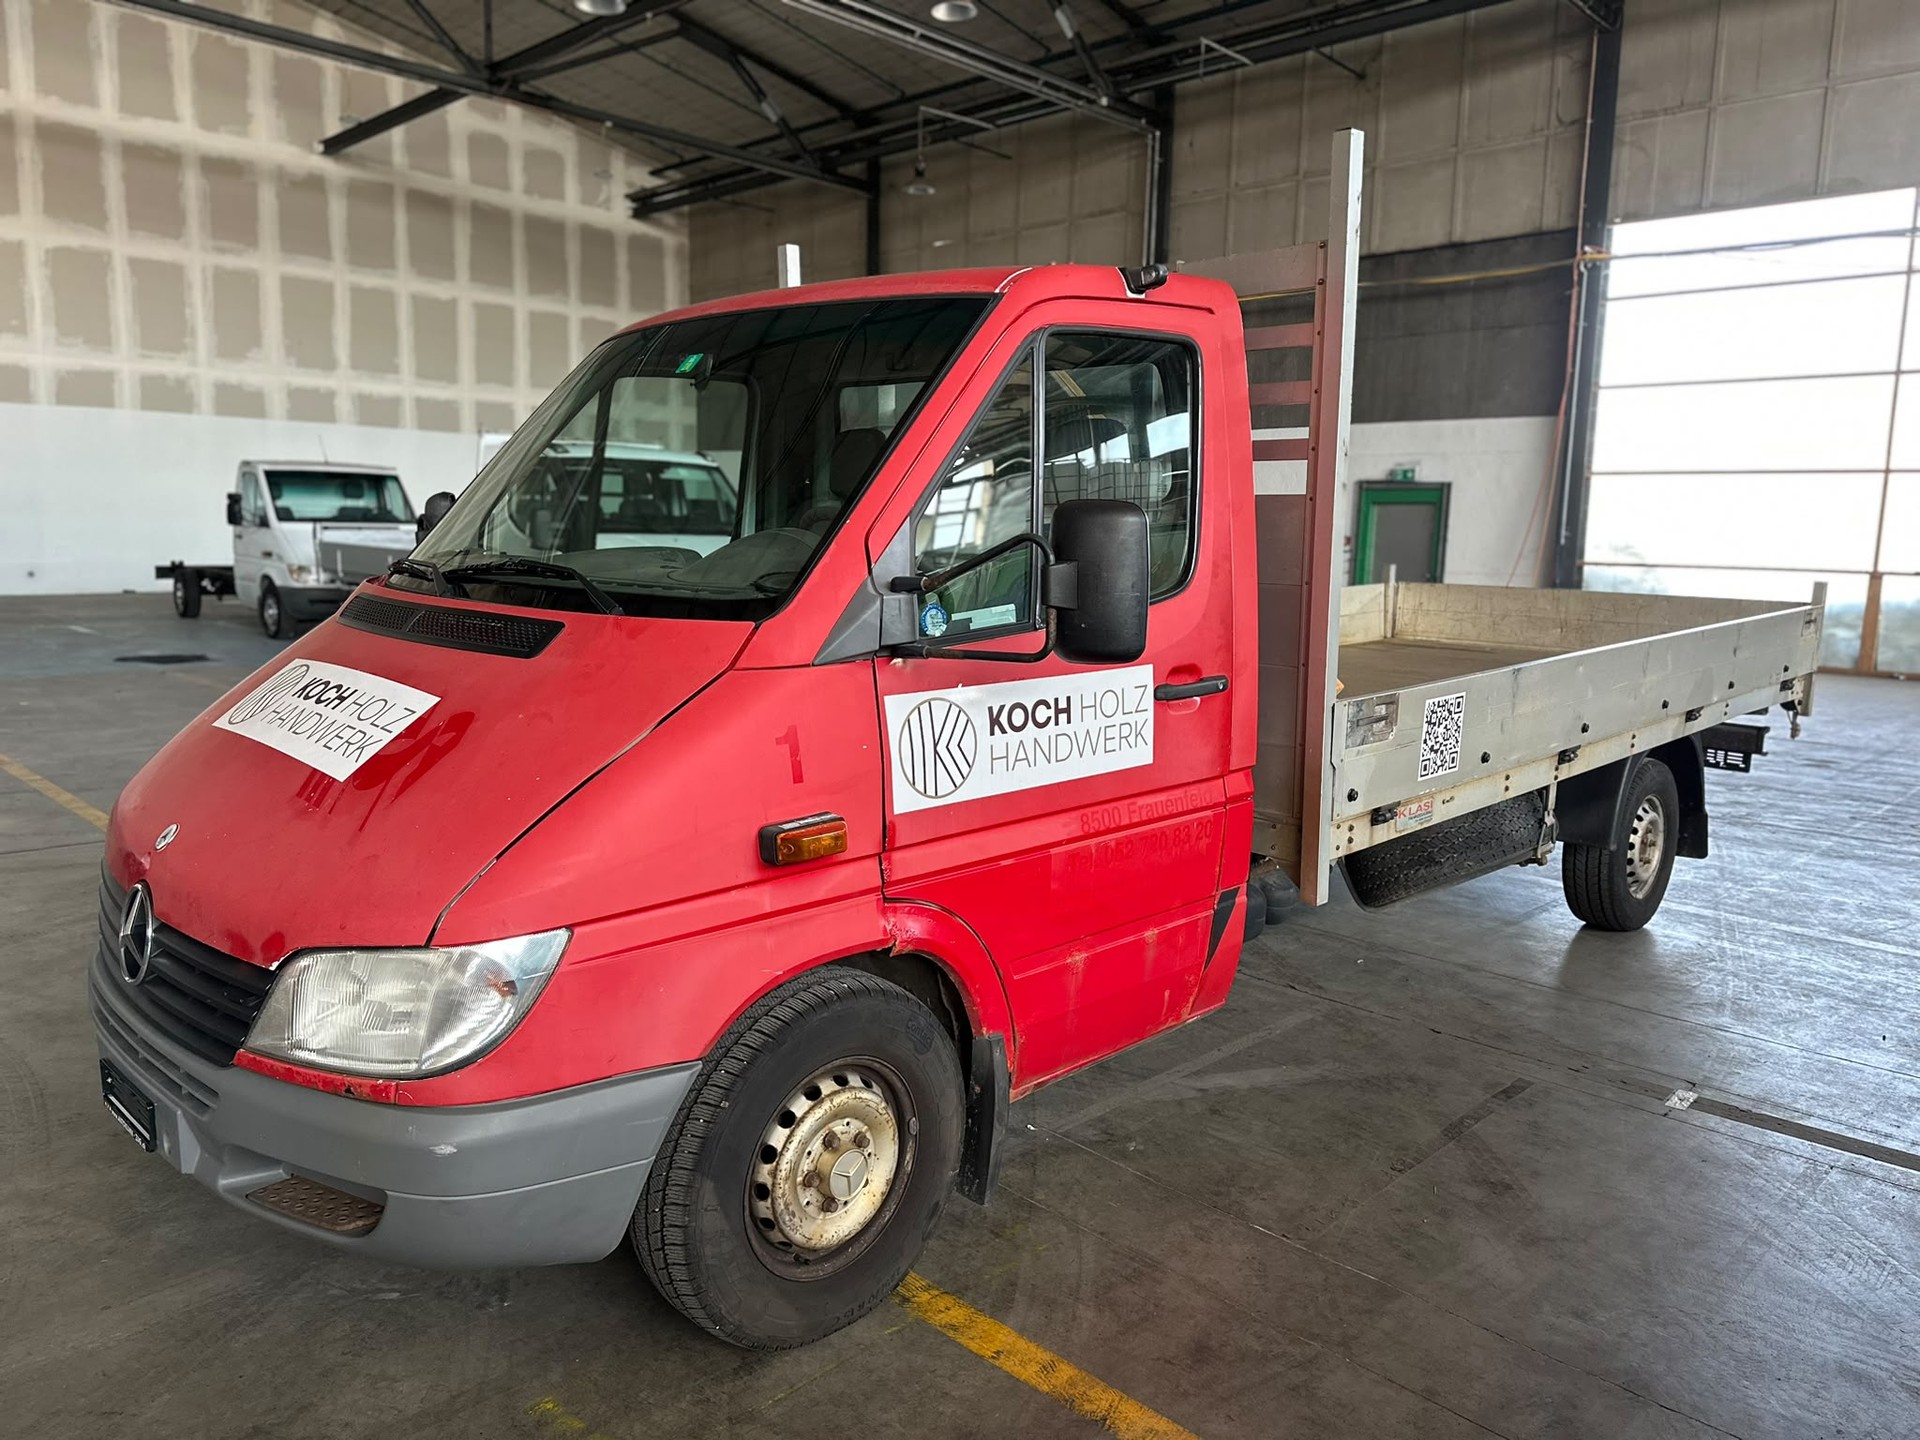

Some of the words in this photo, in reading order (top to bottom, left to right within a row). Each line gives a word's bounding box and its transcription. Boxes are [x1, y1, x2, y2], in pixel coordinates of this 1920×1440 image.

[261, 701, 384, 763] HANDWERK
[291, 677, 359, 710] KOCH
[340, 692, 417, 734] HOLZ
[987, 695, 1071, 736] KOCH
[1081, 684, 1148, 722] HOLZ
[775, 724, 804, 784] 1
[990, 718, 1148, 775] HANDWERK
[1080, 806, 1121, 834] 8500
